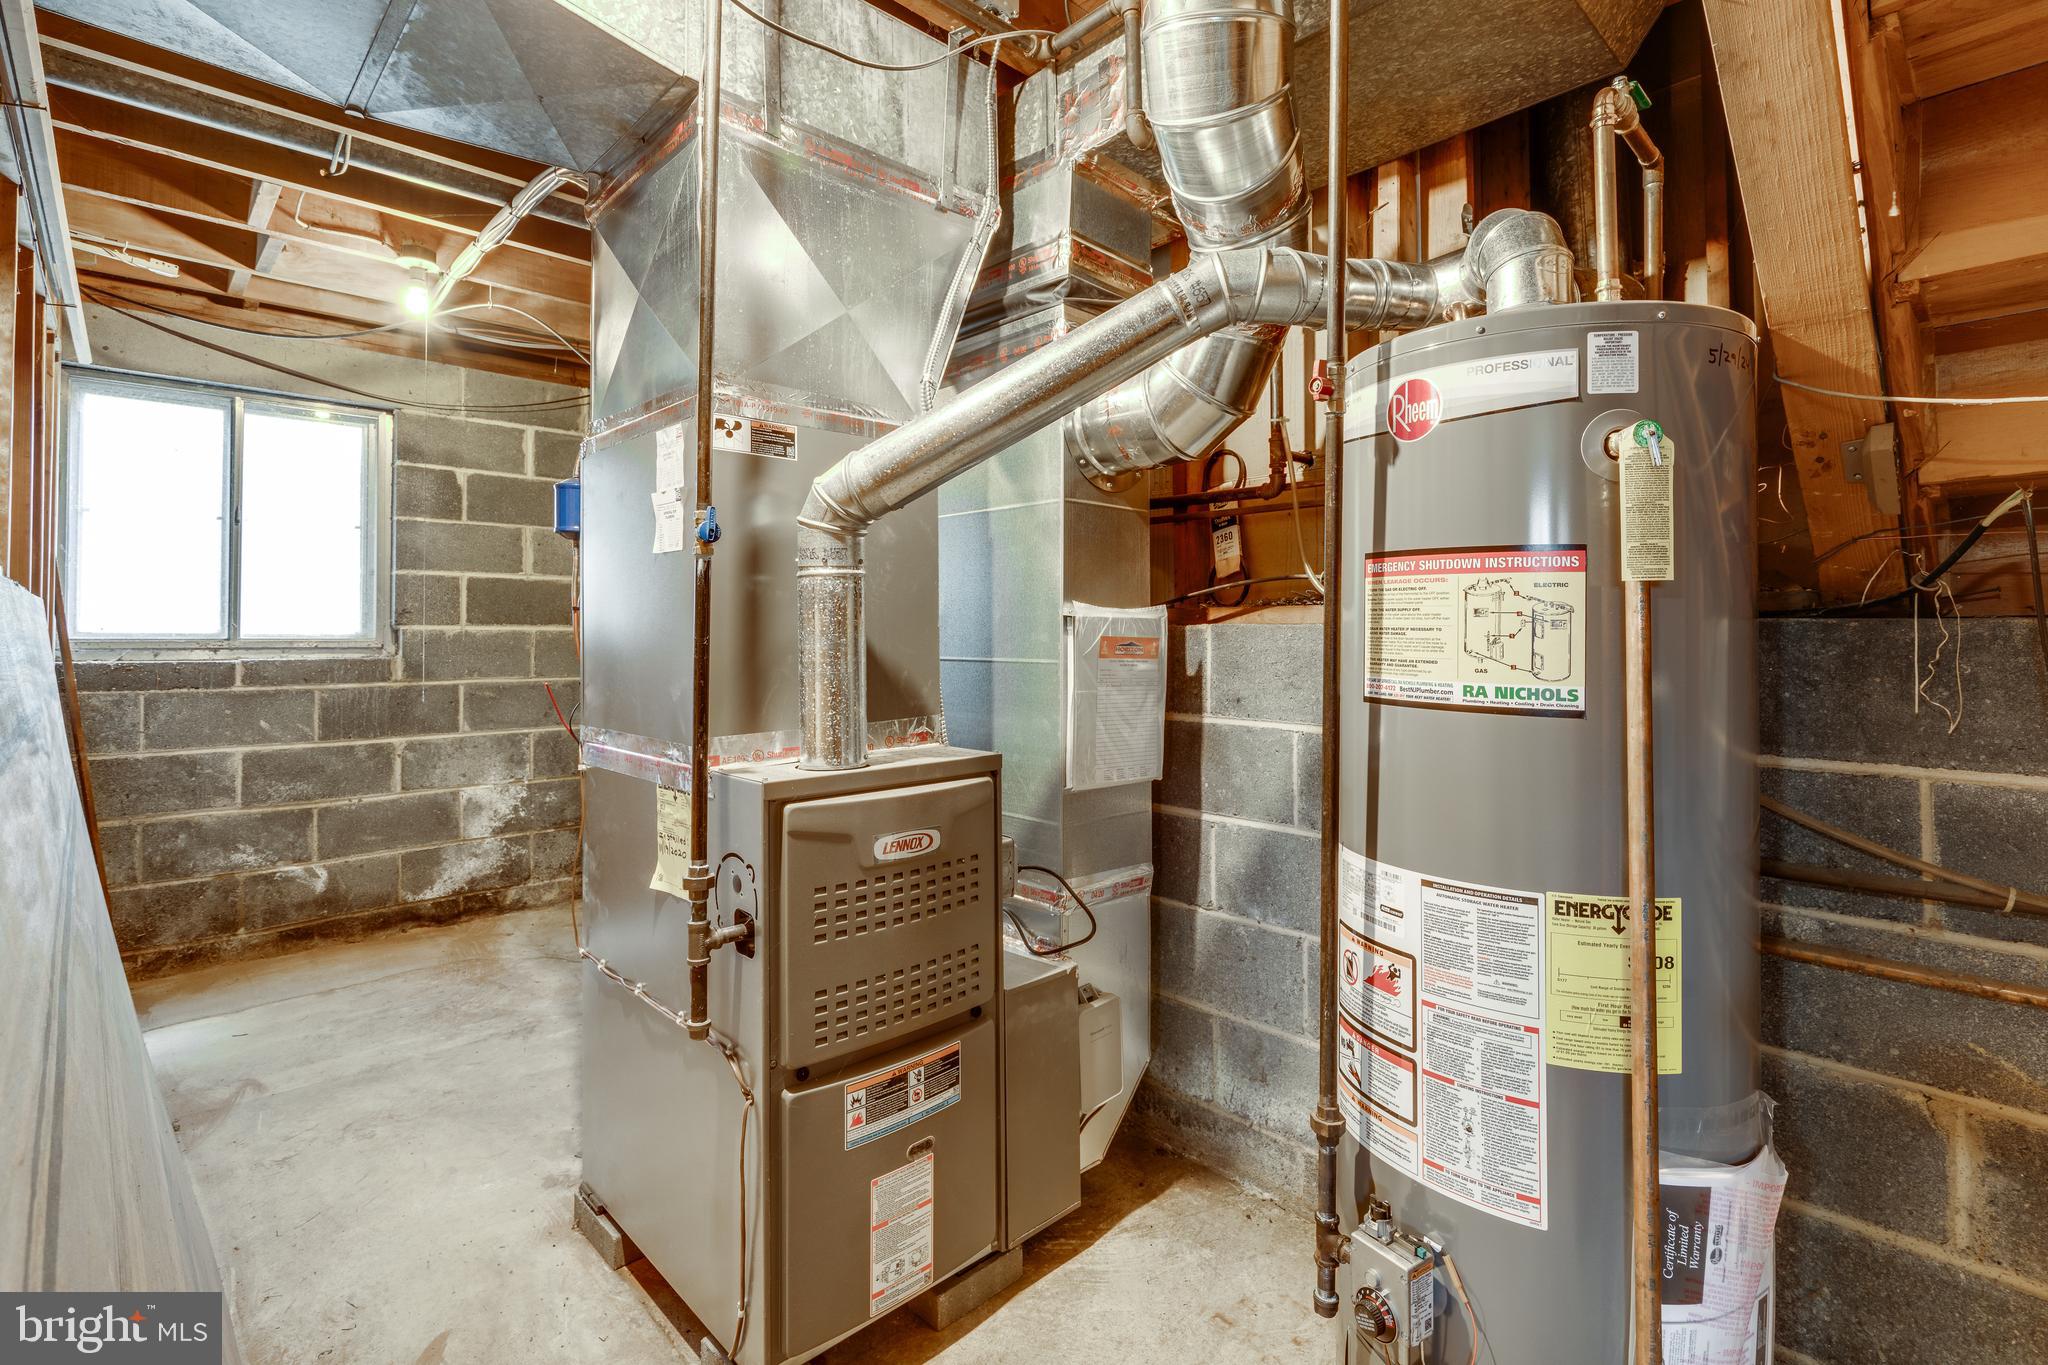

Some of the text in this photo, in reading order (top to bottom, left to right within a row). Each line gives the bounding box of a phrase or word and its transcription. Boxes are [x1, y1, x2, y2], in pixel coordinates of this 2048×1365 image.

[1392, 381, 1438, 432] Rheem
[1216, 531, 1233, 544] 2360
[1367, 555, 1580, 574] EMERGENCY SHUTDOWN INSTRUCTIONS
[1400, 686, 1454, 696] BestNJPlumber.com
[1462, 685, 1580, 703] RA NICHOLS
[881, 836, 925, 856] LENNOX
[1432, 883, 1463, 893] INSTALLATION
[1474, 891, 1502, 900] OPERATION
[1502, 894, 1522, 902] DETAILS
[1356, 938, 1384, 957] WARNING
[1578, 940, 1602, 948] Estimated
[1446, 1008, 1456, 1016] YOUR
[1456, 1011, 1470, 1019] SAFETY
[1482, 1018, 1498, 1027] BEFORE
[1498, 1022, 1522, 1031] OPERATING
[1356, 1035, 1380, 1054] DANGER
[898, 1059, 924, 1075] WARNING
[1457, 1083, 1504, 1100] LIGHTING INSTRUCTIONS
[1356, 1100, 1383, 1122] WARNING
[1492, 1187, 1515, 1198] APPLIANCE
[1663, 1207, 1680, 1279] Certificate of
[1677, 1224, 1689, 1266] Limited
[1689, 1220, 1704, 1269] Warranty
